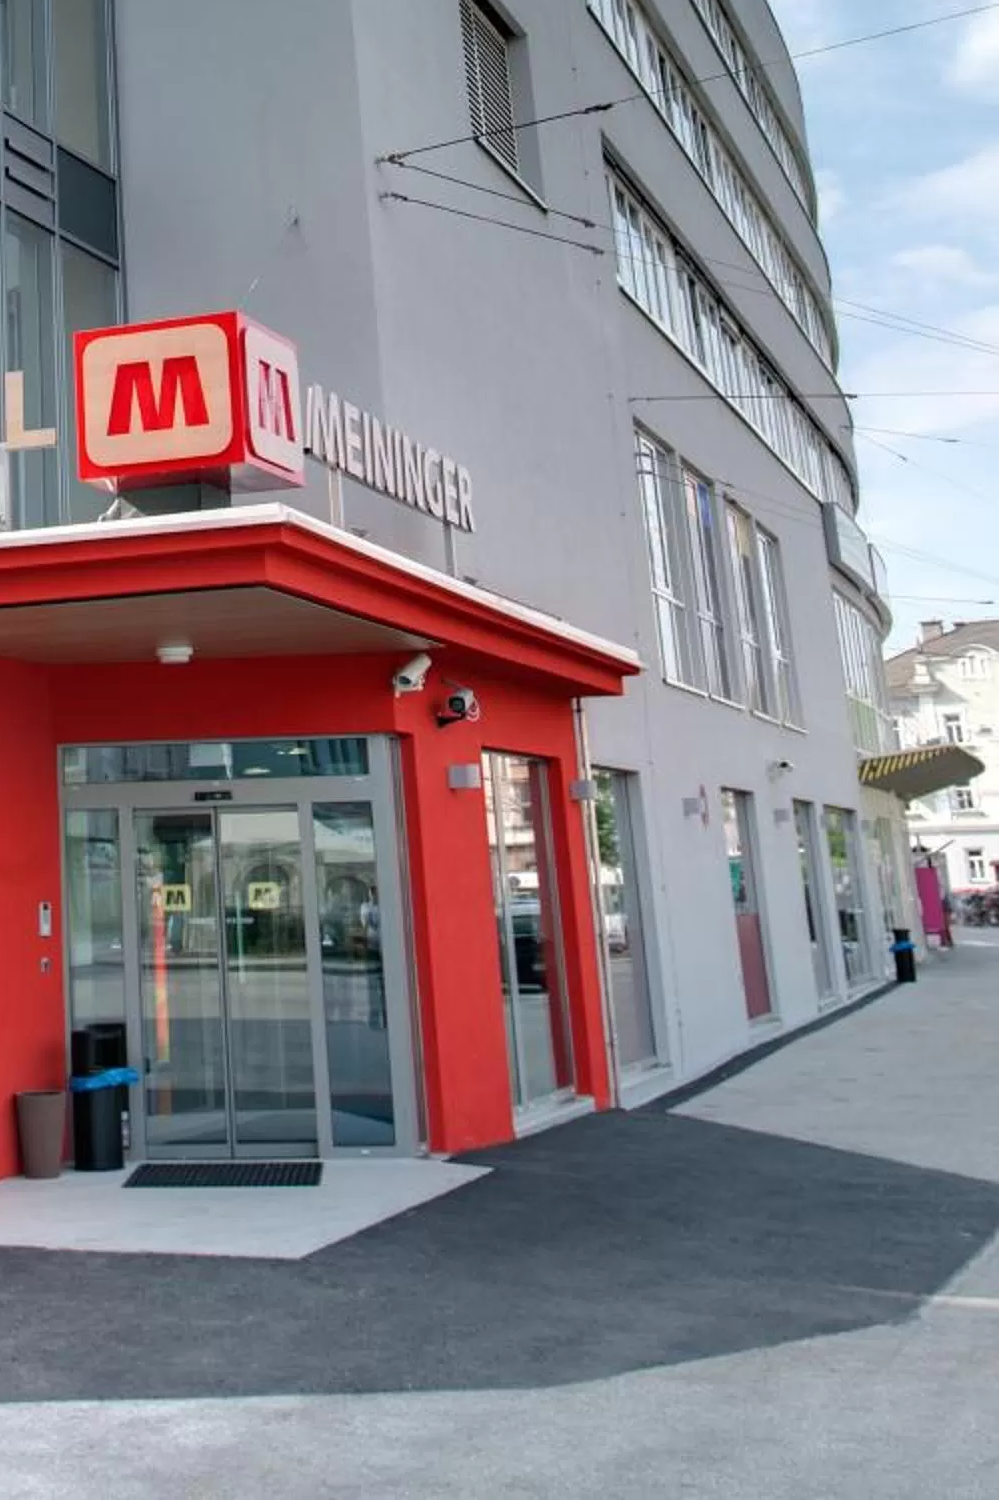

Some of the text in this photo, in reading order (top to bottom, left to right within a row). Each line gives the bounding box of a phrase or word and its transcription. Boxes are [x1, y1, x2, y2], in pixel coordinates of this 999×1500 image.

[106, 355, 210, 437] M
[258, 359, 296, 443] M
[303, 383, 477, 534] MEININGER
